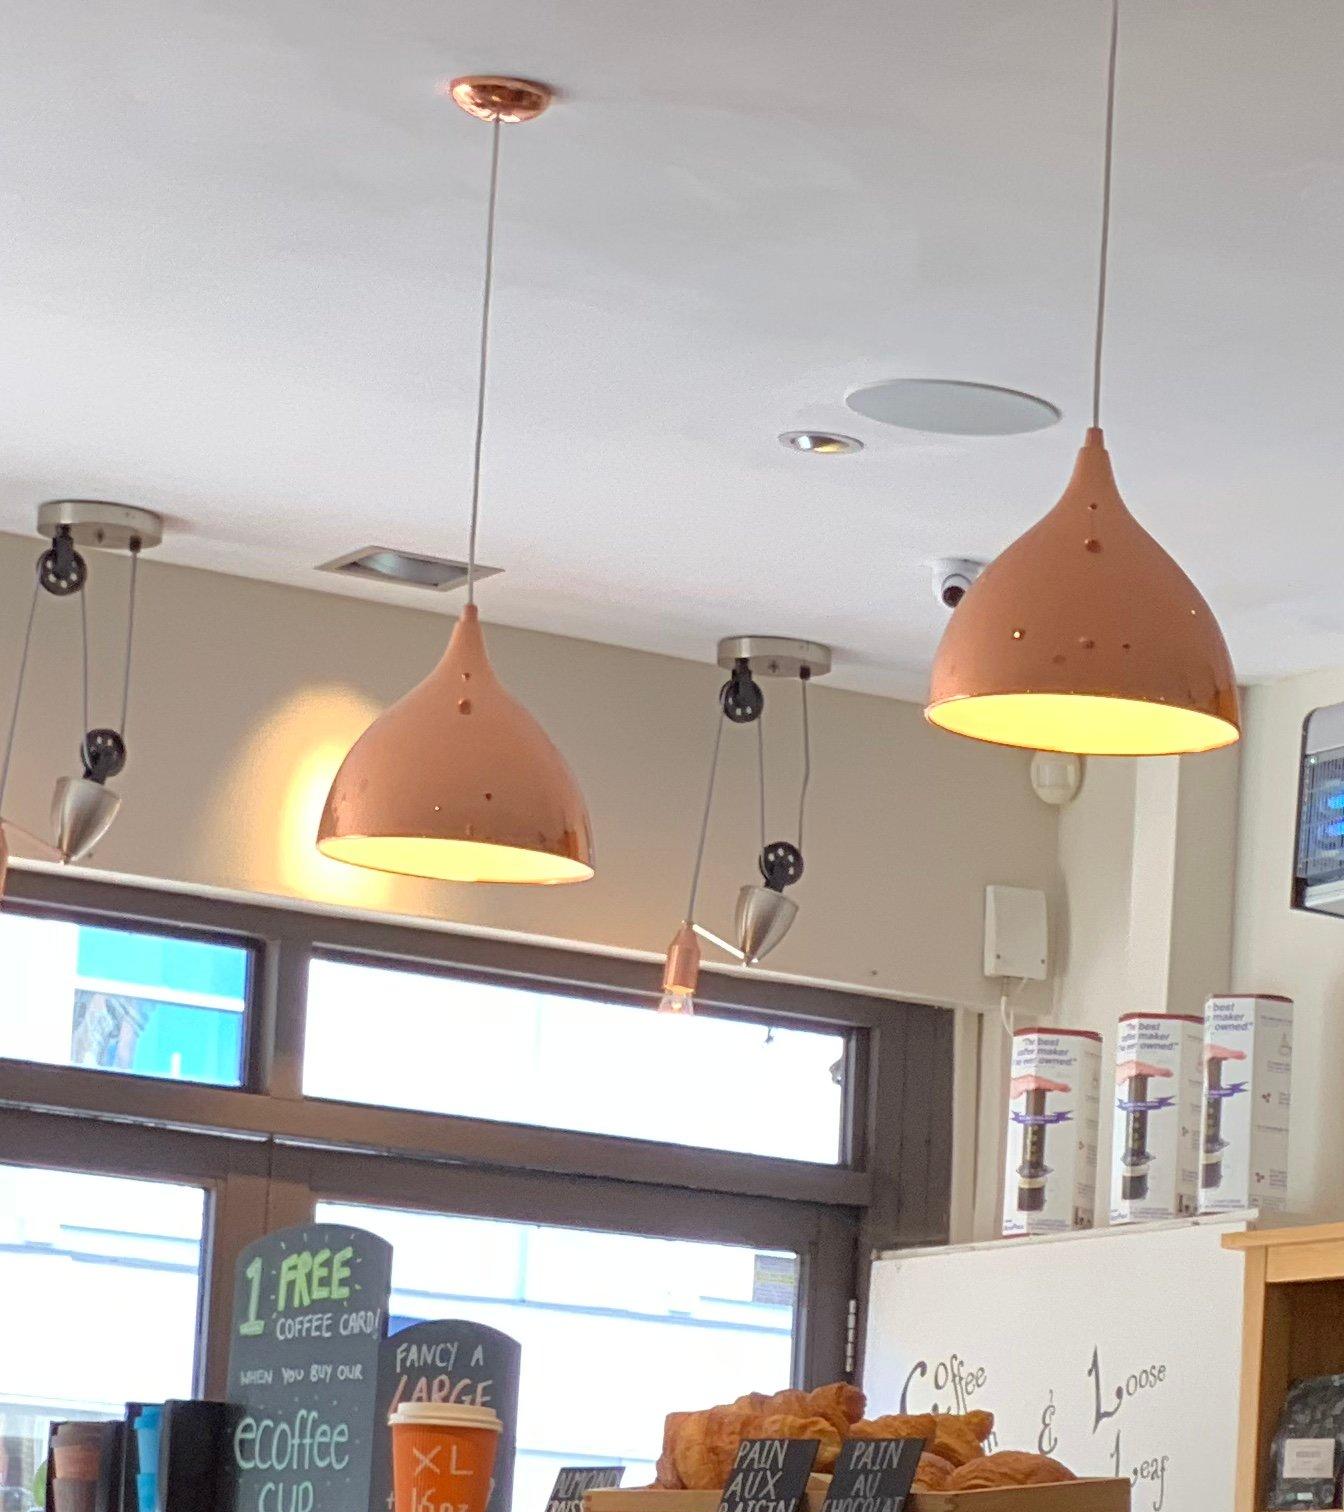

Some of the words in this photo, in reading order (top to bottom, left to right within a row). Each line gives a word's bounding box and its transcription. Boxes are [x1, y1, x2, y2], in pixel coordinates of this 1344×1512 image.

[240, 1257, 265, 1336] 1
[278, 1247, 353, 1311] FREE
[276, 1312, 332, 1340] COFFEE
[340, 1309, 380, 1339] CARD!
[396, 1342, 458, 1373] FANCY
[471, 1345, 484, 1367] A
[240, 1369, 273, 1385] WHEN
[310, 1364, 331, 1382] BUY
[337, 1364, 362, 1380] OUR
[234, 1409, 349, 1470] ecoffee
[734, 1440, 789, 1469] PAIN
[850, 1441, 903, 1470] PAIN
[723, 1471, 782, 1501] AUX
[851, 1472, 881, 1497] AU
